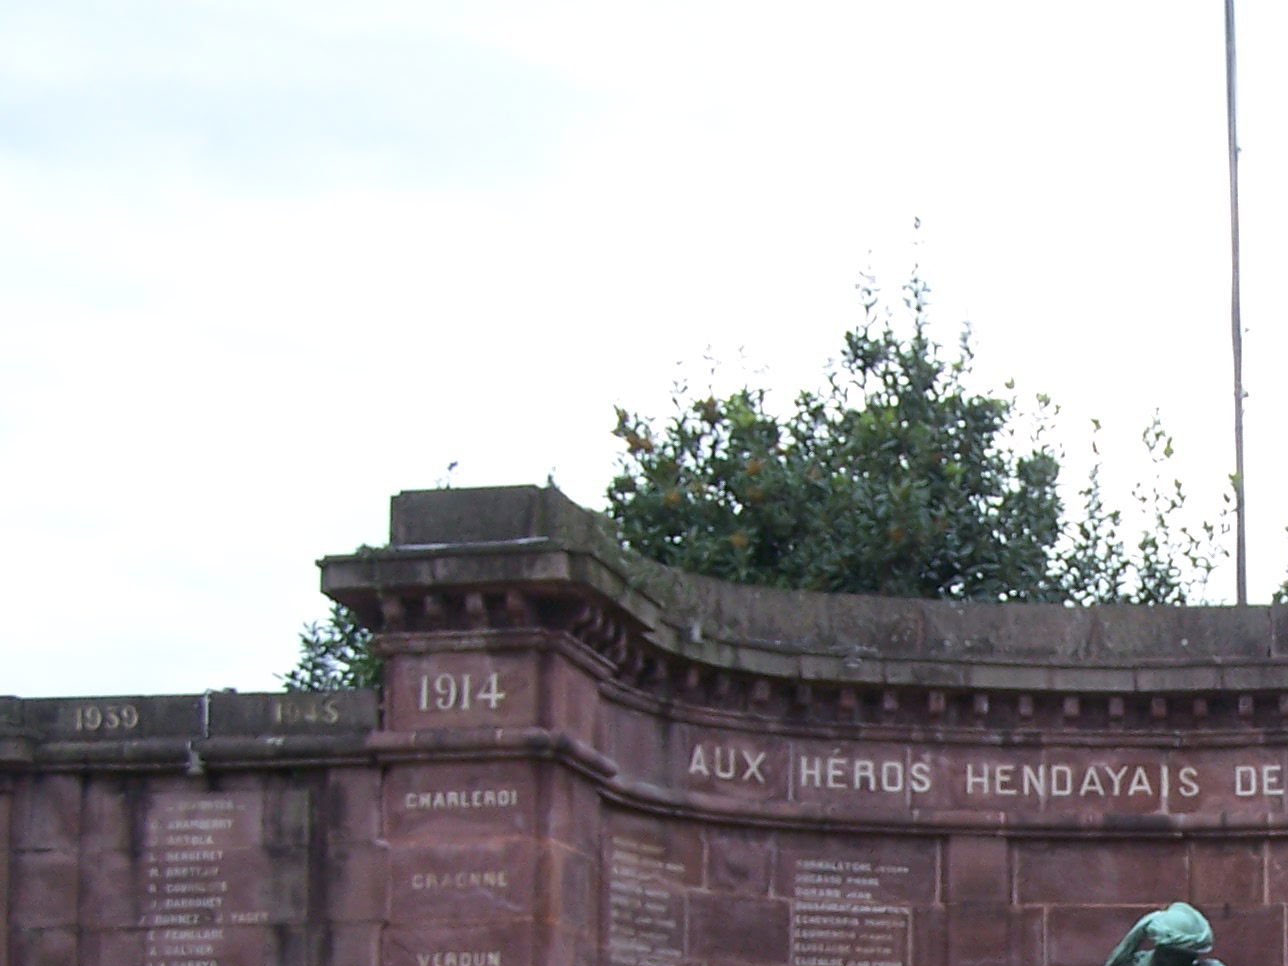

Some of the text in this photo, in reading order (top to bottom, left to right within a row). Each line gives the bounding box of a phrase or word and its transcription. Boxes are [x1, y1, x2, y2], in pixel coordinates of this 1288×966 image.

[418, 670, 506, 712] 1914
[74, 704, 140, 732] 1939
[688, 743, 766, 784] AUX
[800, 748, 932, 794] HÉROS
[966, 762, 1200, 799] HENDAYAIS
[1236, 764, 1284, 798] DE
[404, 788, 518, 810] CHARLEROI
